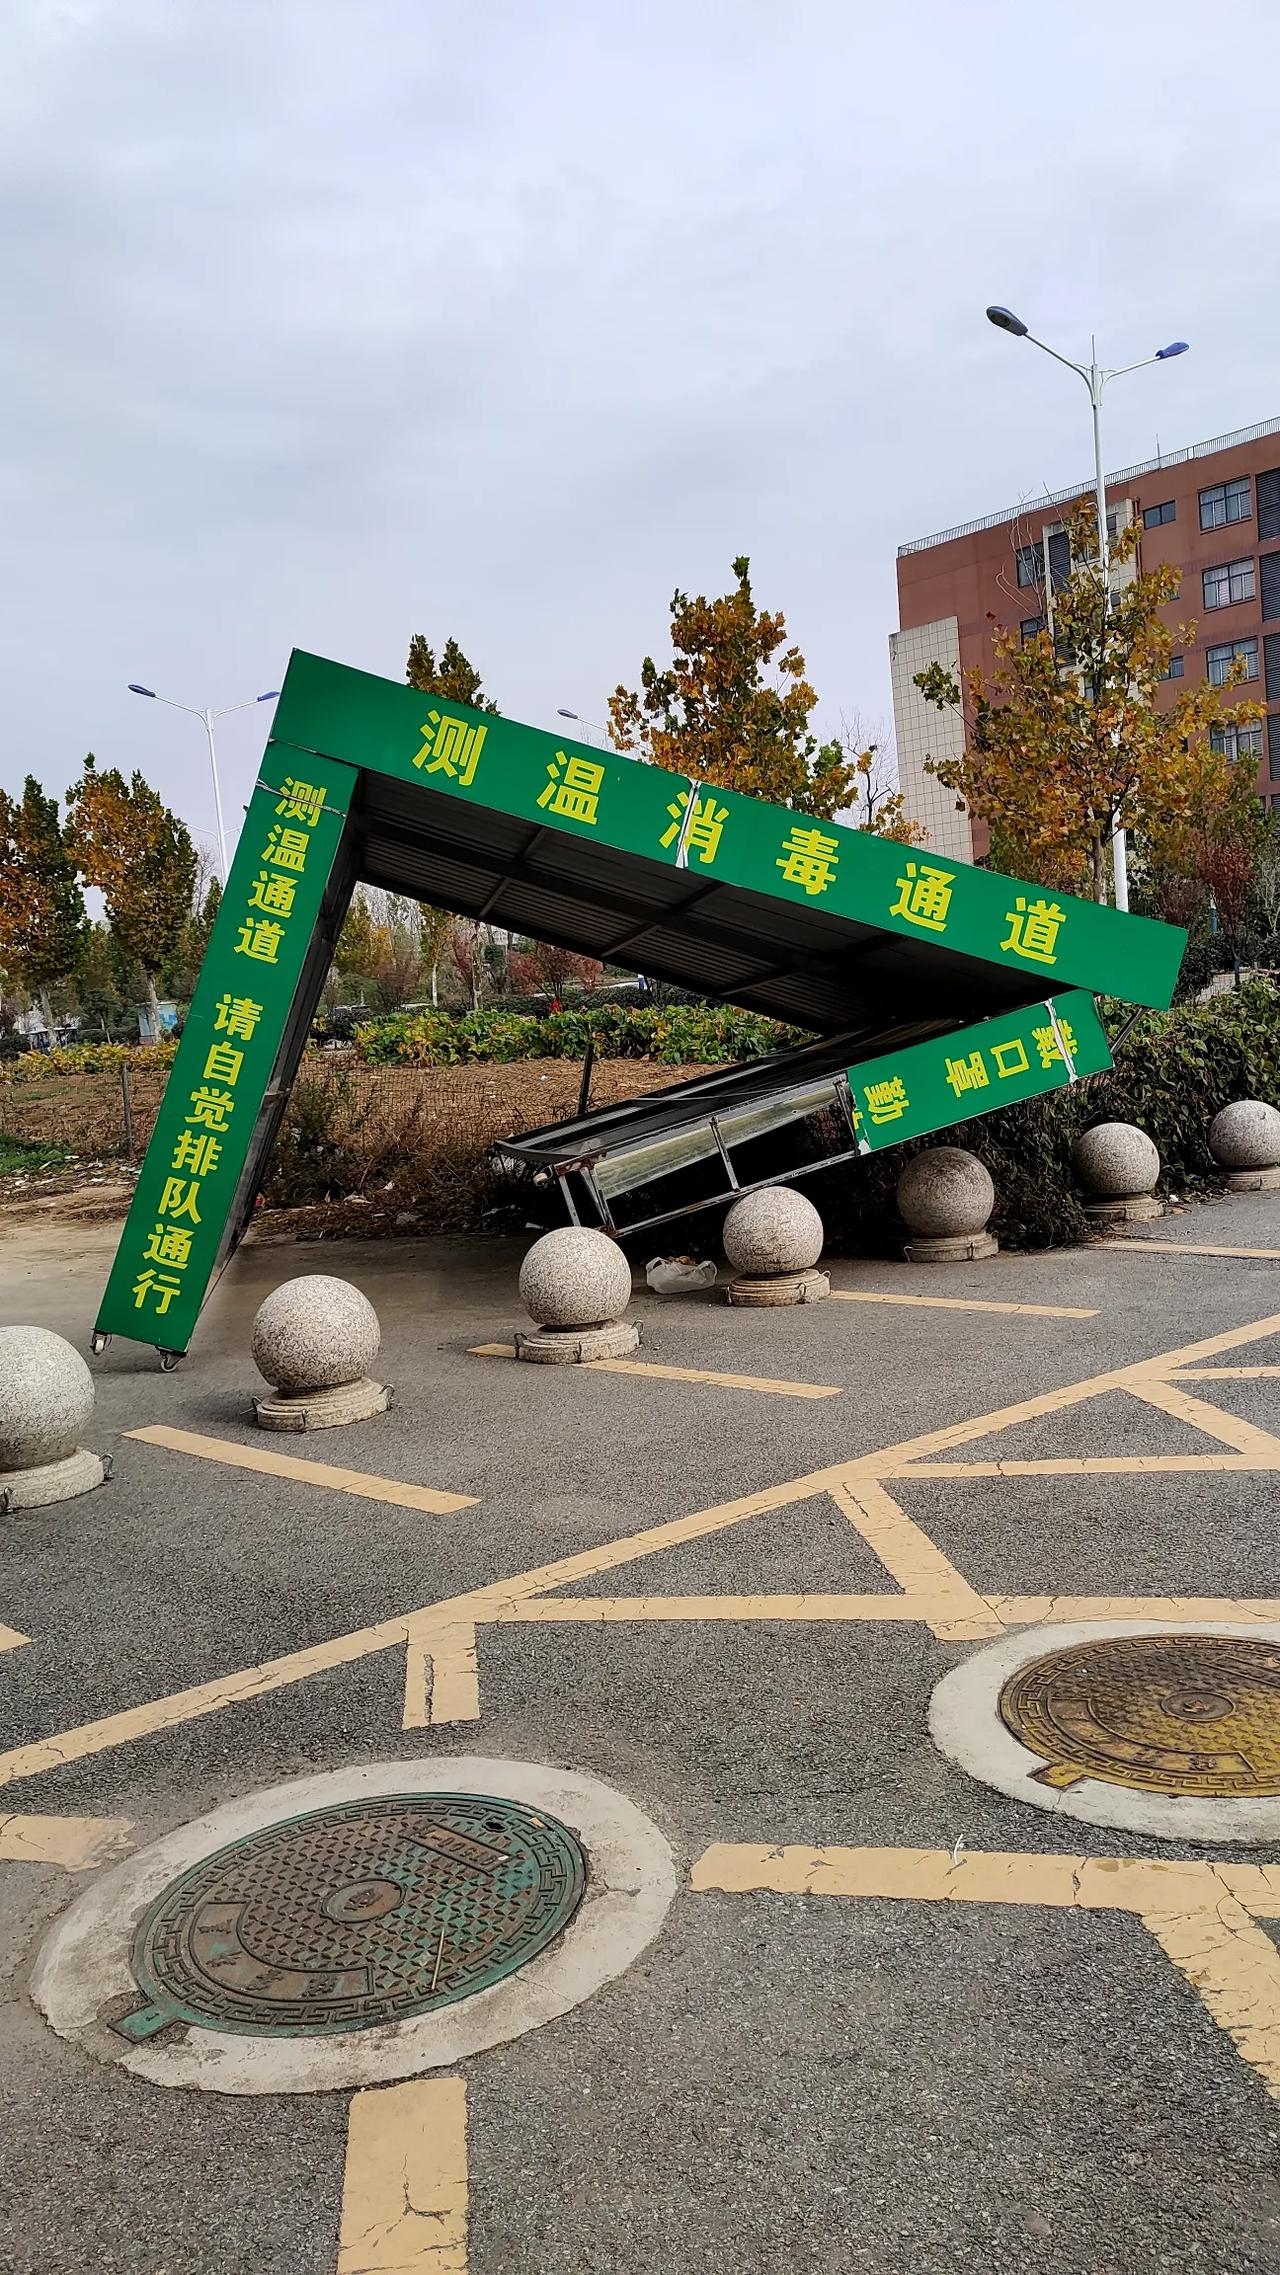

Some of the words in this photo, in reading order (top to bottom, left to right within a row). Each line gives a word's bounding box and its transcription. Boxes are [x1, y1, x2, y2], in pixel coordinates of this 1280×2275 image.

[234, 776, 327, 965] 测温通道
[412, 710, 1067, 965] 测温消毒通道
[851, 1076, 910, 1130] 勤
[944, 1019, 1078, 1098] 戴口罩
[132, 994, 263, 1314] 请自觉排队通行
